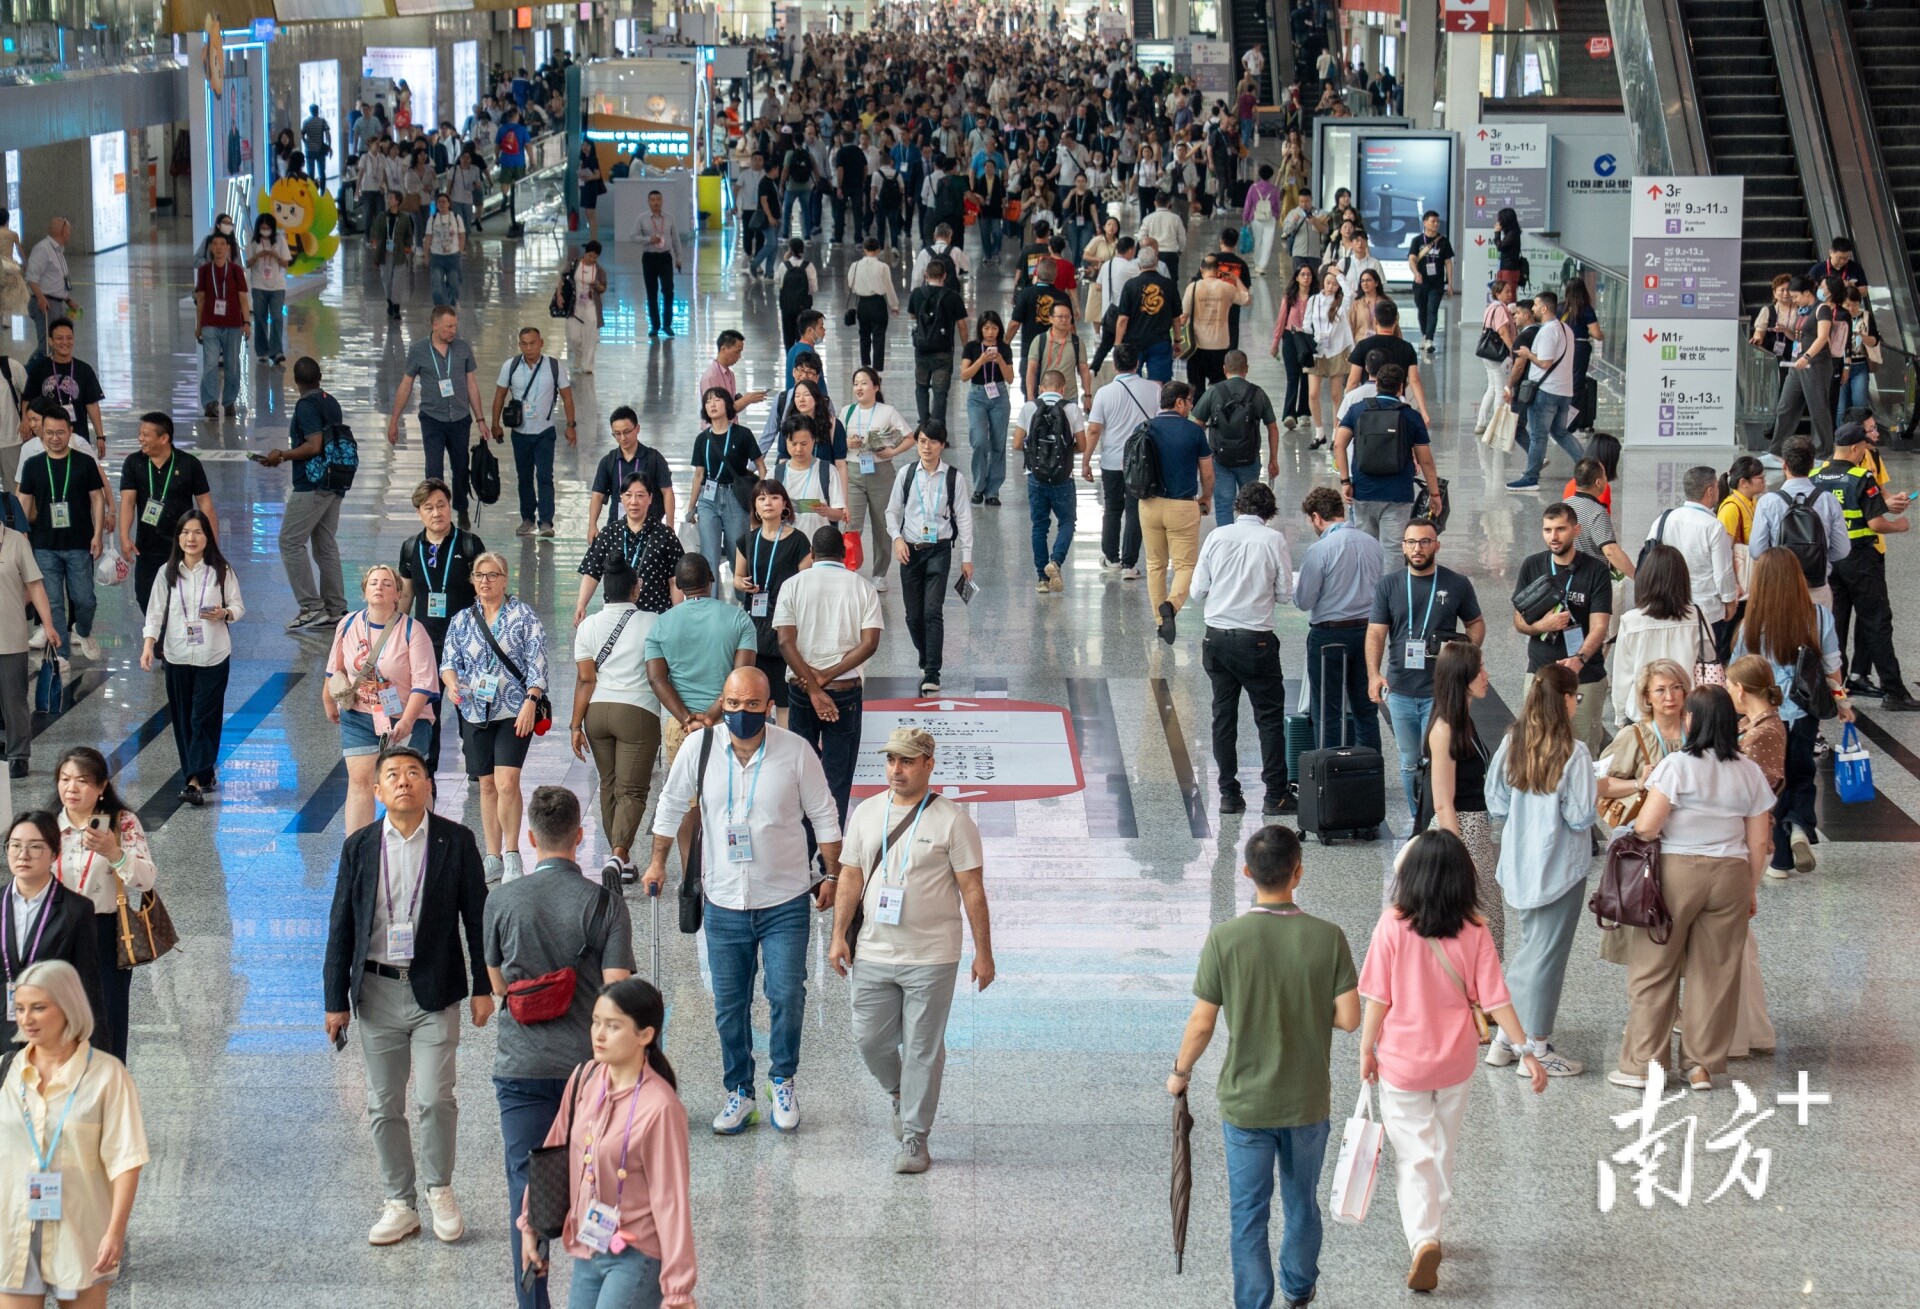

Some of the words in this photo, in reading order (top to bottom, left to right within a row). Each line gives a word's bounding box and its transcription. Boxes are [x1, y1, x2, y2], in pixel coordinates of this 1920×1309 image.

[1491, 129, 1502, 138] 3F
[1476, 180, 1488, 190] 2F
[1568, 180, 1632, 188] 中国建设银
[1666, 184, 1682, 197] 3F
[1685, 203, 1728, 214] 9.3-11.3
[1645, 253, 1660, 267] 2F
[1662, 333, 1683, 342] M1F
[1661, 376, 1676, 388] 1F
[1678, 392, 1721, 403] 9.1-13.1
